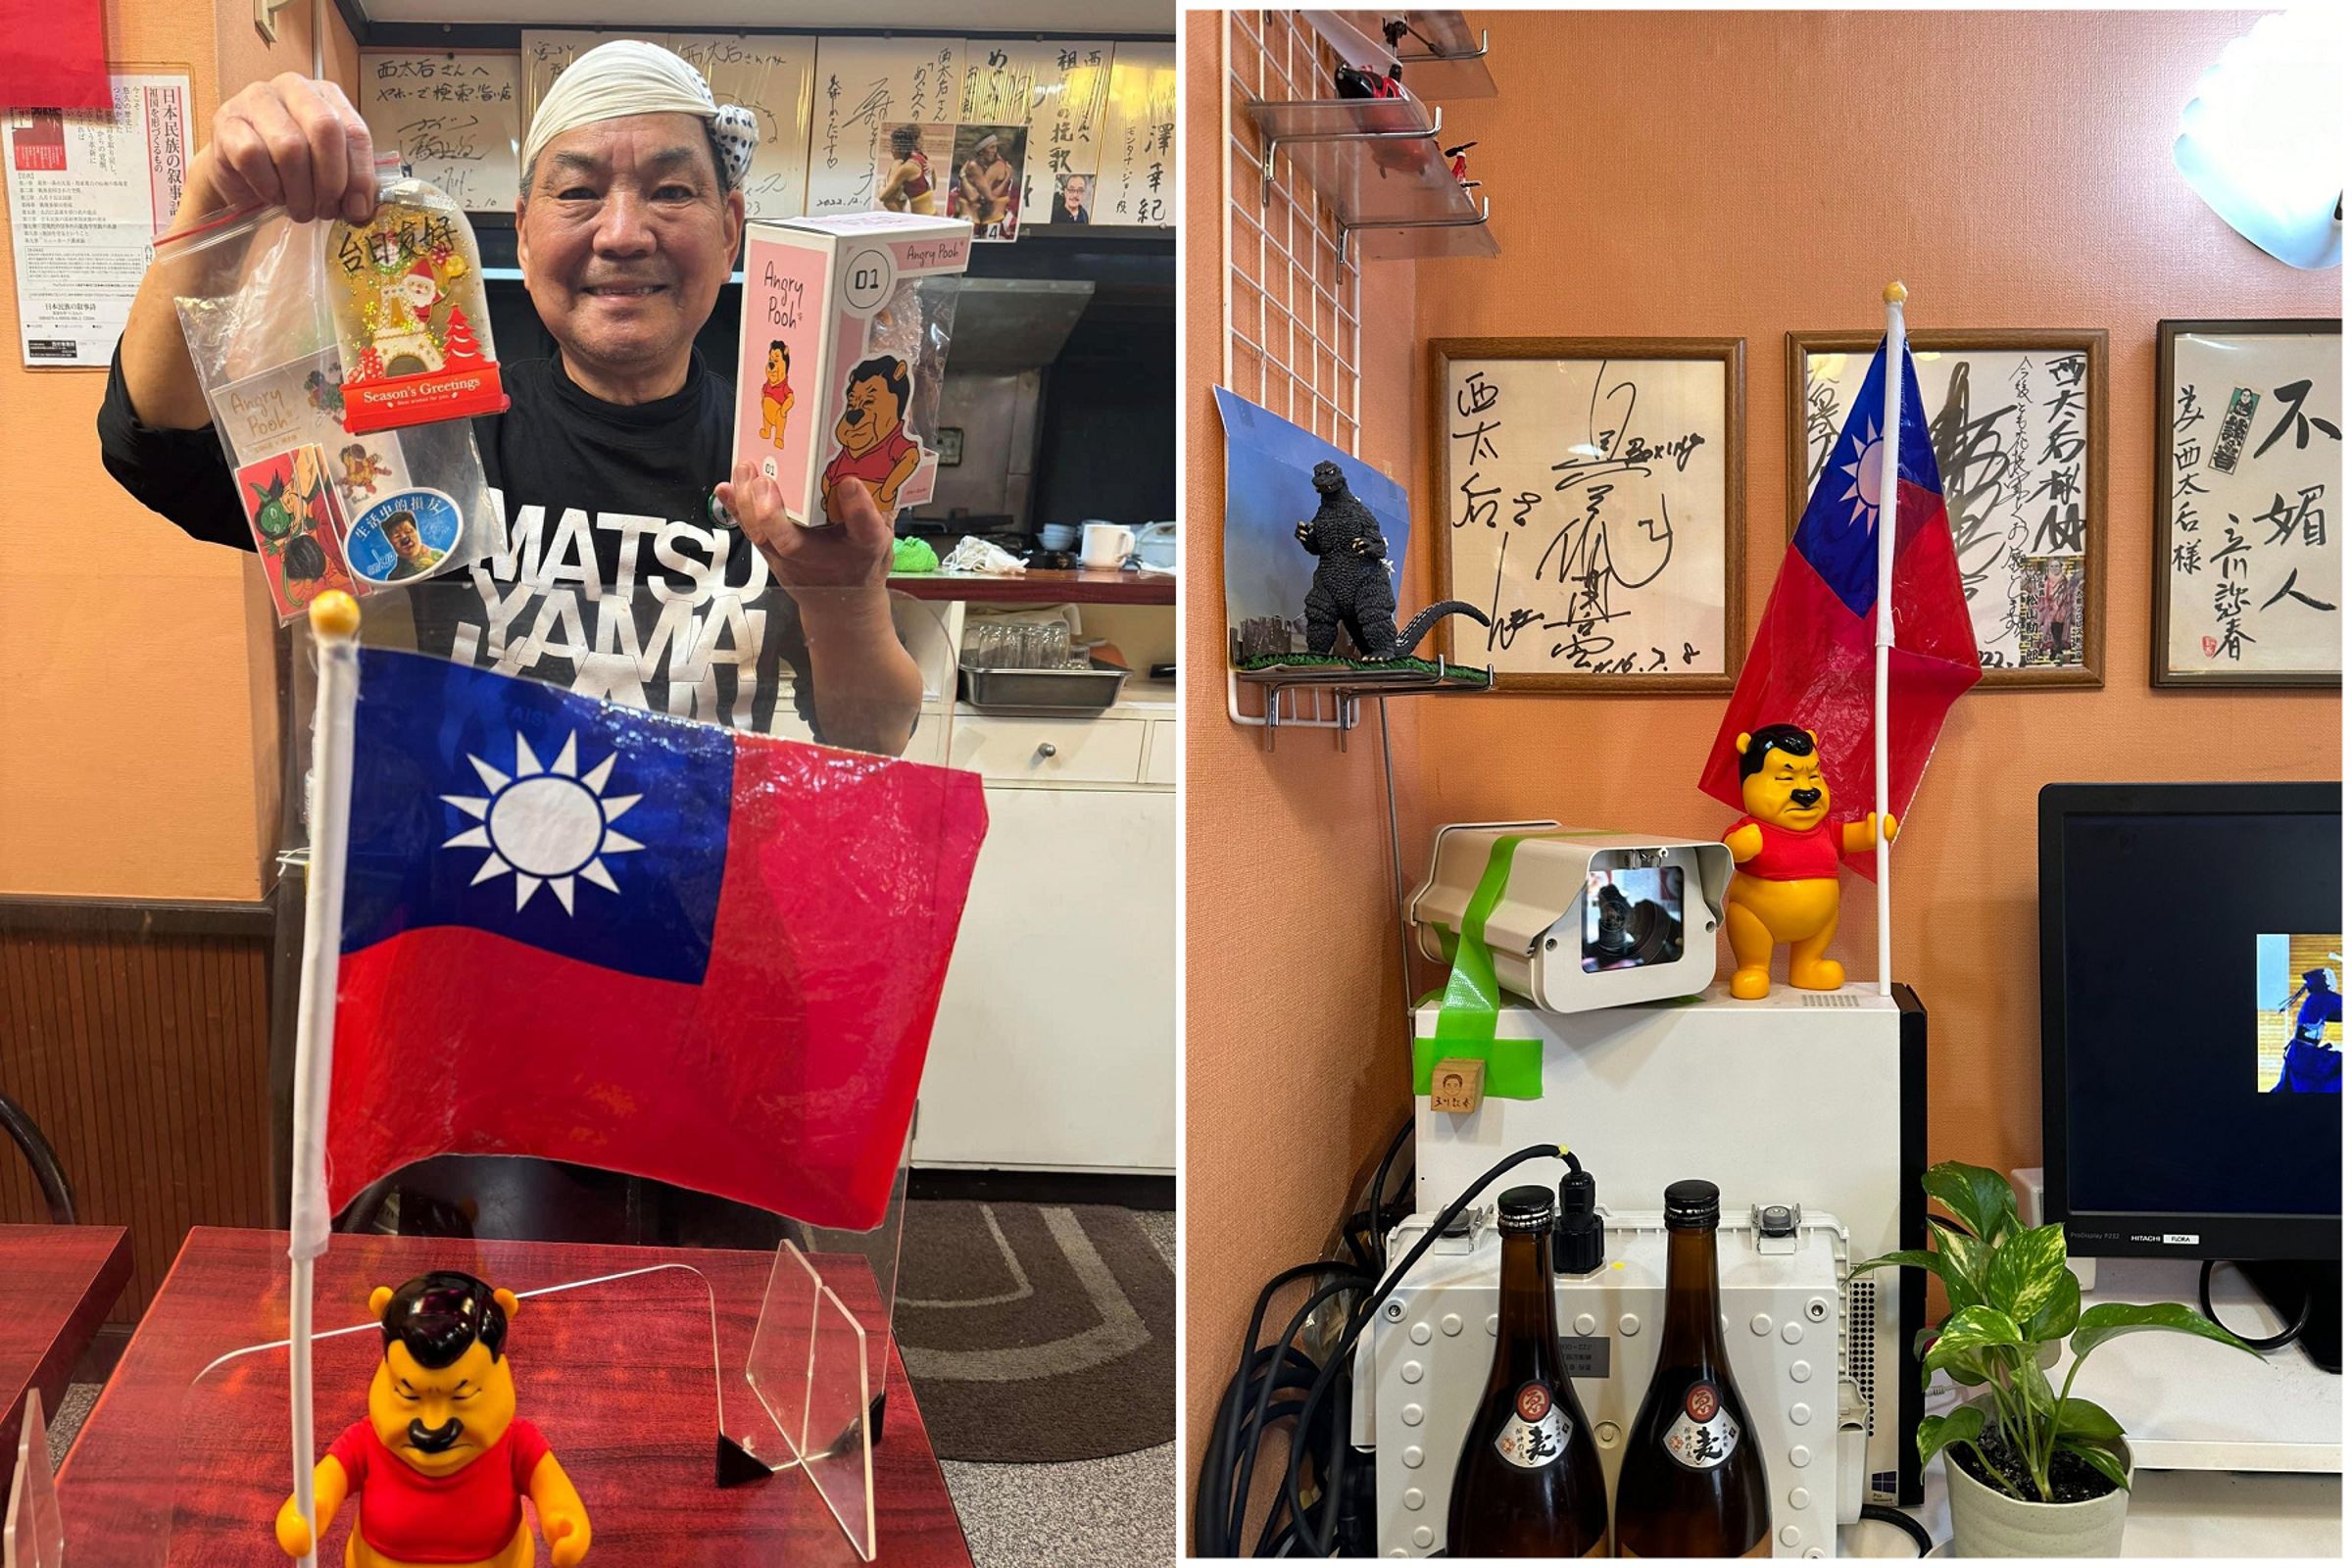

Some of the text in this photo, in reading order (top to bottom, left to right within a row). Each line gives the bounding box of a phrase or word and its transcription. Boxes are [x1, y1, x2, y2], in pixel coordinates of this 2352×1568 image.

[906, 243, 958, 268] Angry Pooh
[763, 261, 804, 308] Angry
[855, 270, 879, 290] 01
[767, 296, 798, 329] Pooh
[230, 390, 285, 416] Angry
[364, 378, 480, 403] Season's Greetings
[247, 407, 288, 437] Pooh
[764, 463, 776, 476] 01
[2253, 378, 2342, 612] 不媚人
[487, 486, 769, 607] MATSU
[469, 566, 757, 682] YAMA
